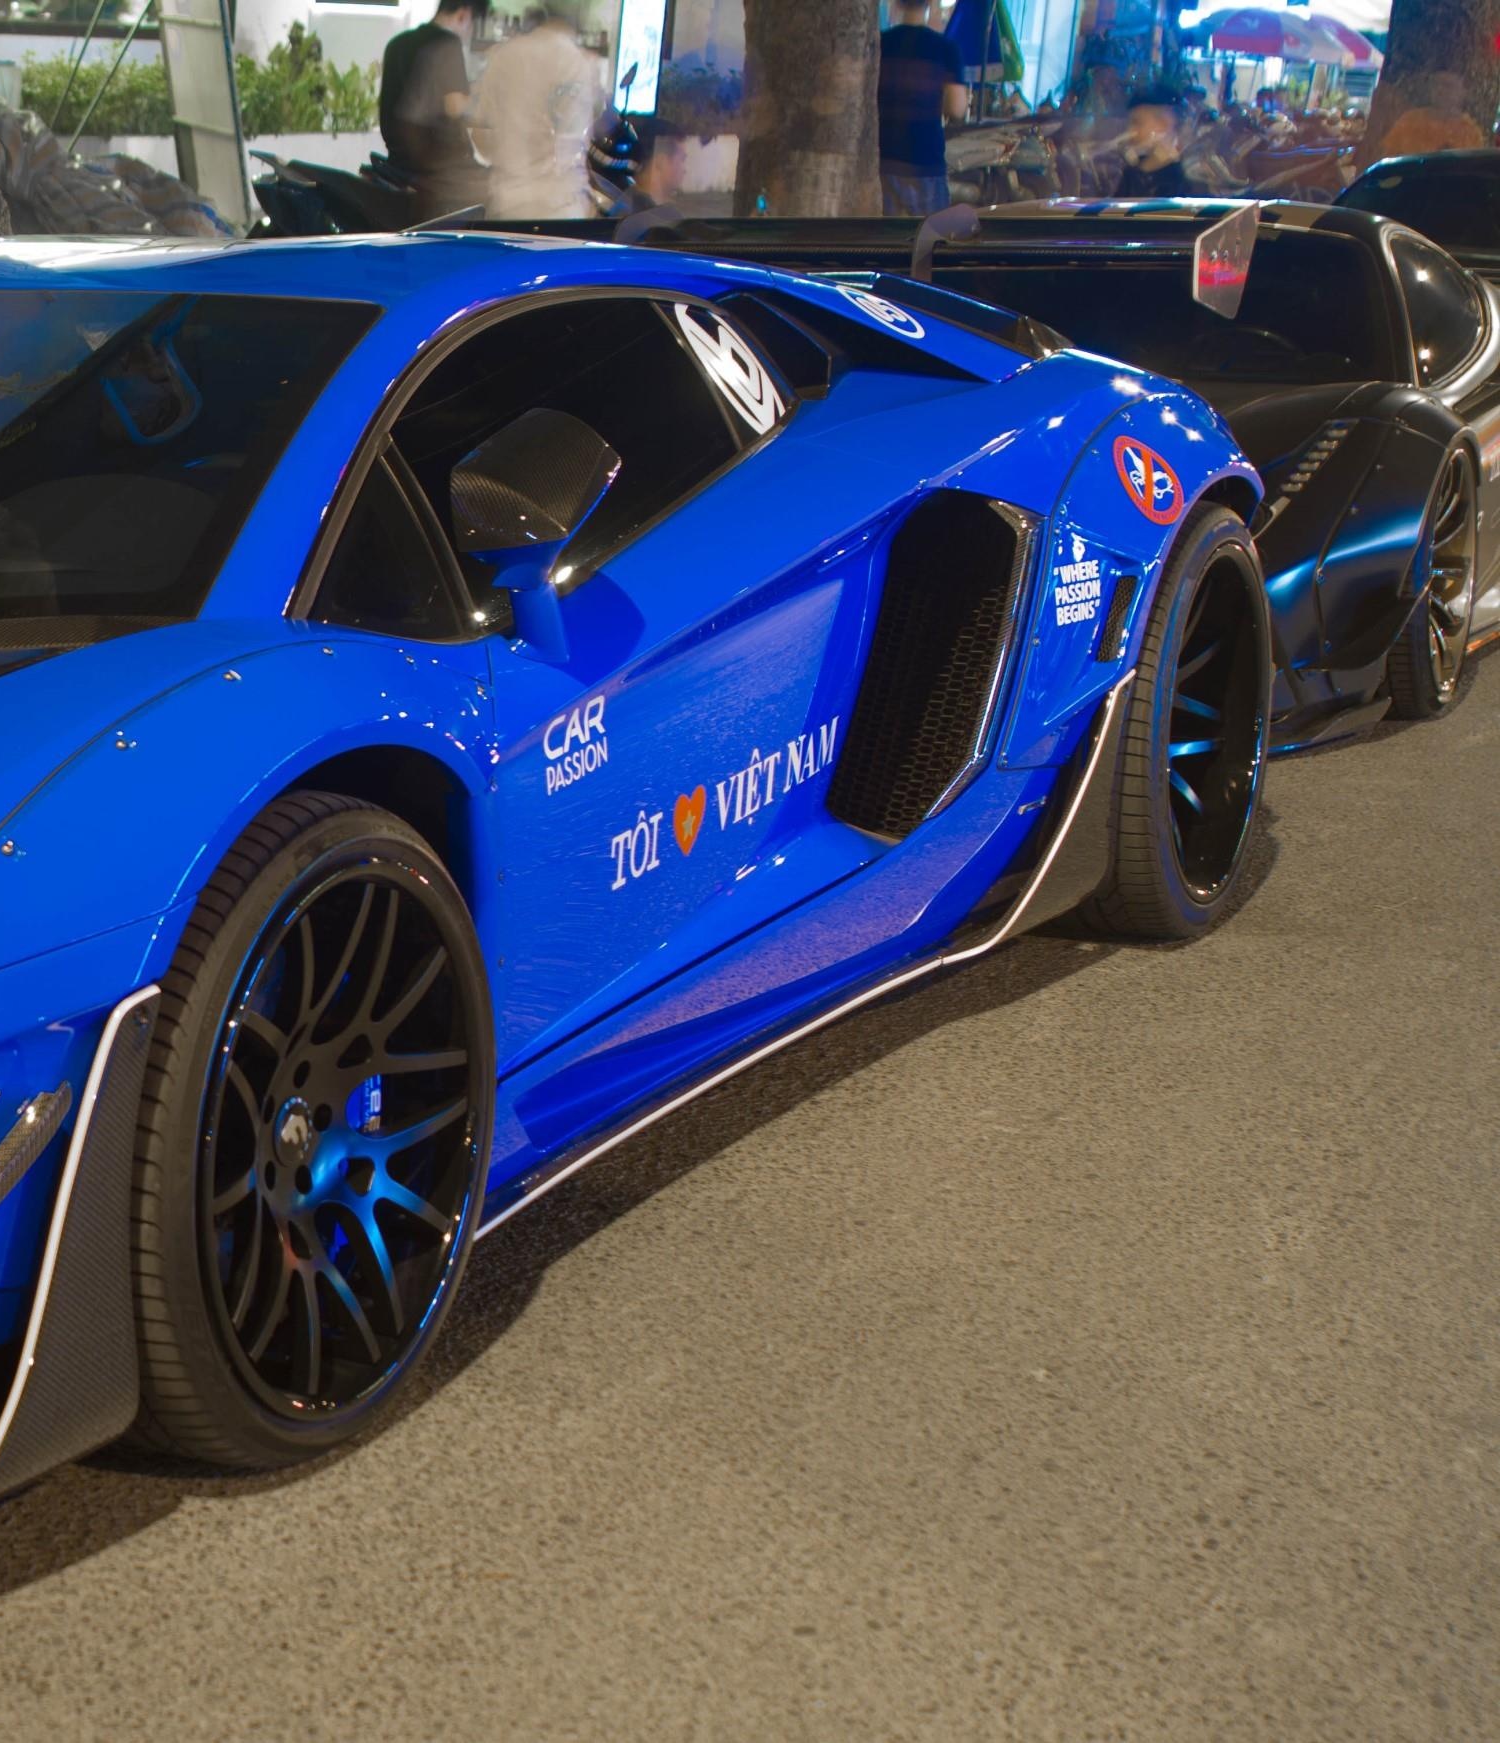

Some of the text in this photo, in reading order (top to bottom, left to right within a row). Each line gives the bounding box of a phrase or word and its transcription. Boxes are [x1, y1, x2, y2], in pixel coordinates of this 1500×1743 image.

[1054, 579, 1101, 606] PASSION
[543, 695, 606, 760] CAR
[545, 736, 608, 795] PASSION
[611, 715, 840, 891] TÔI VIỆT NAM
